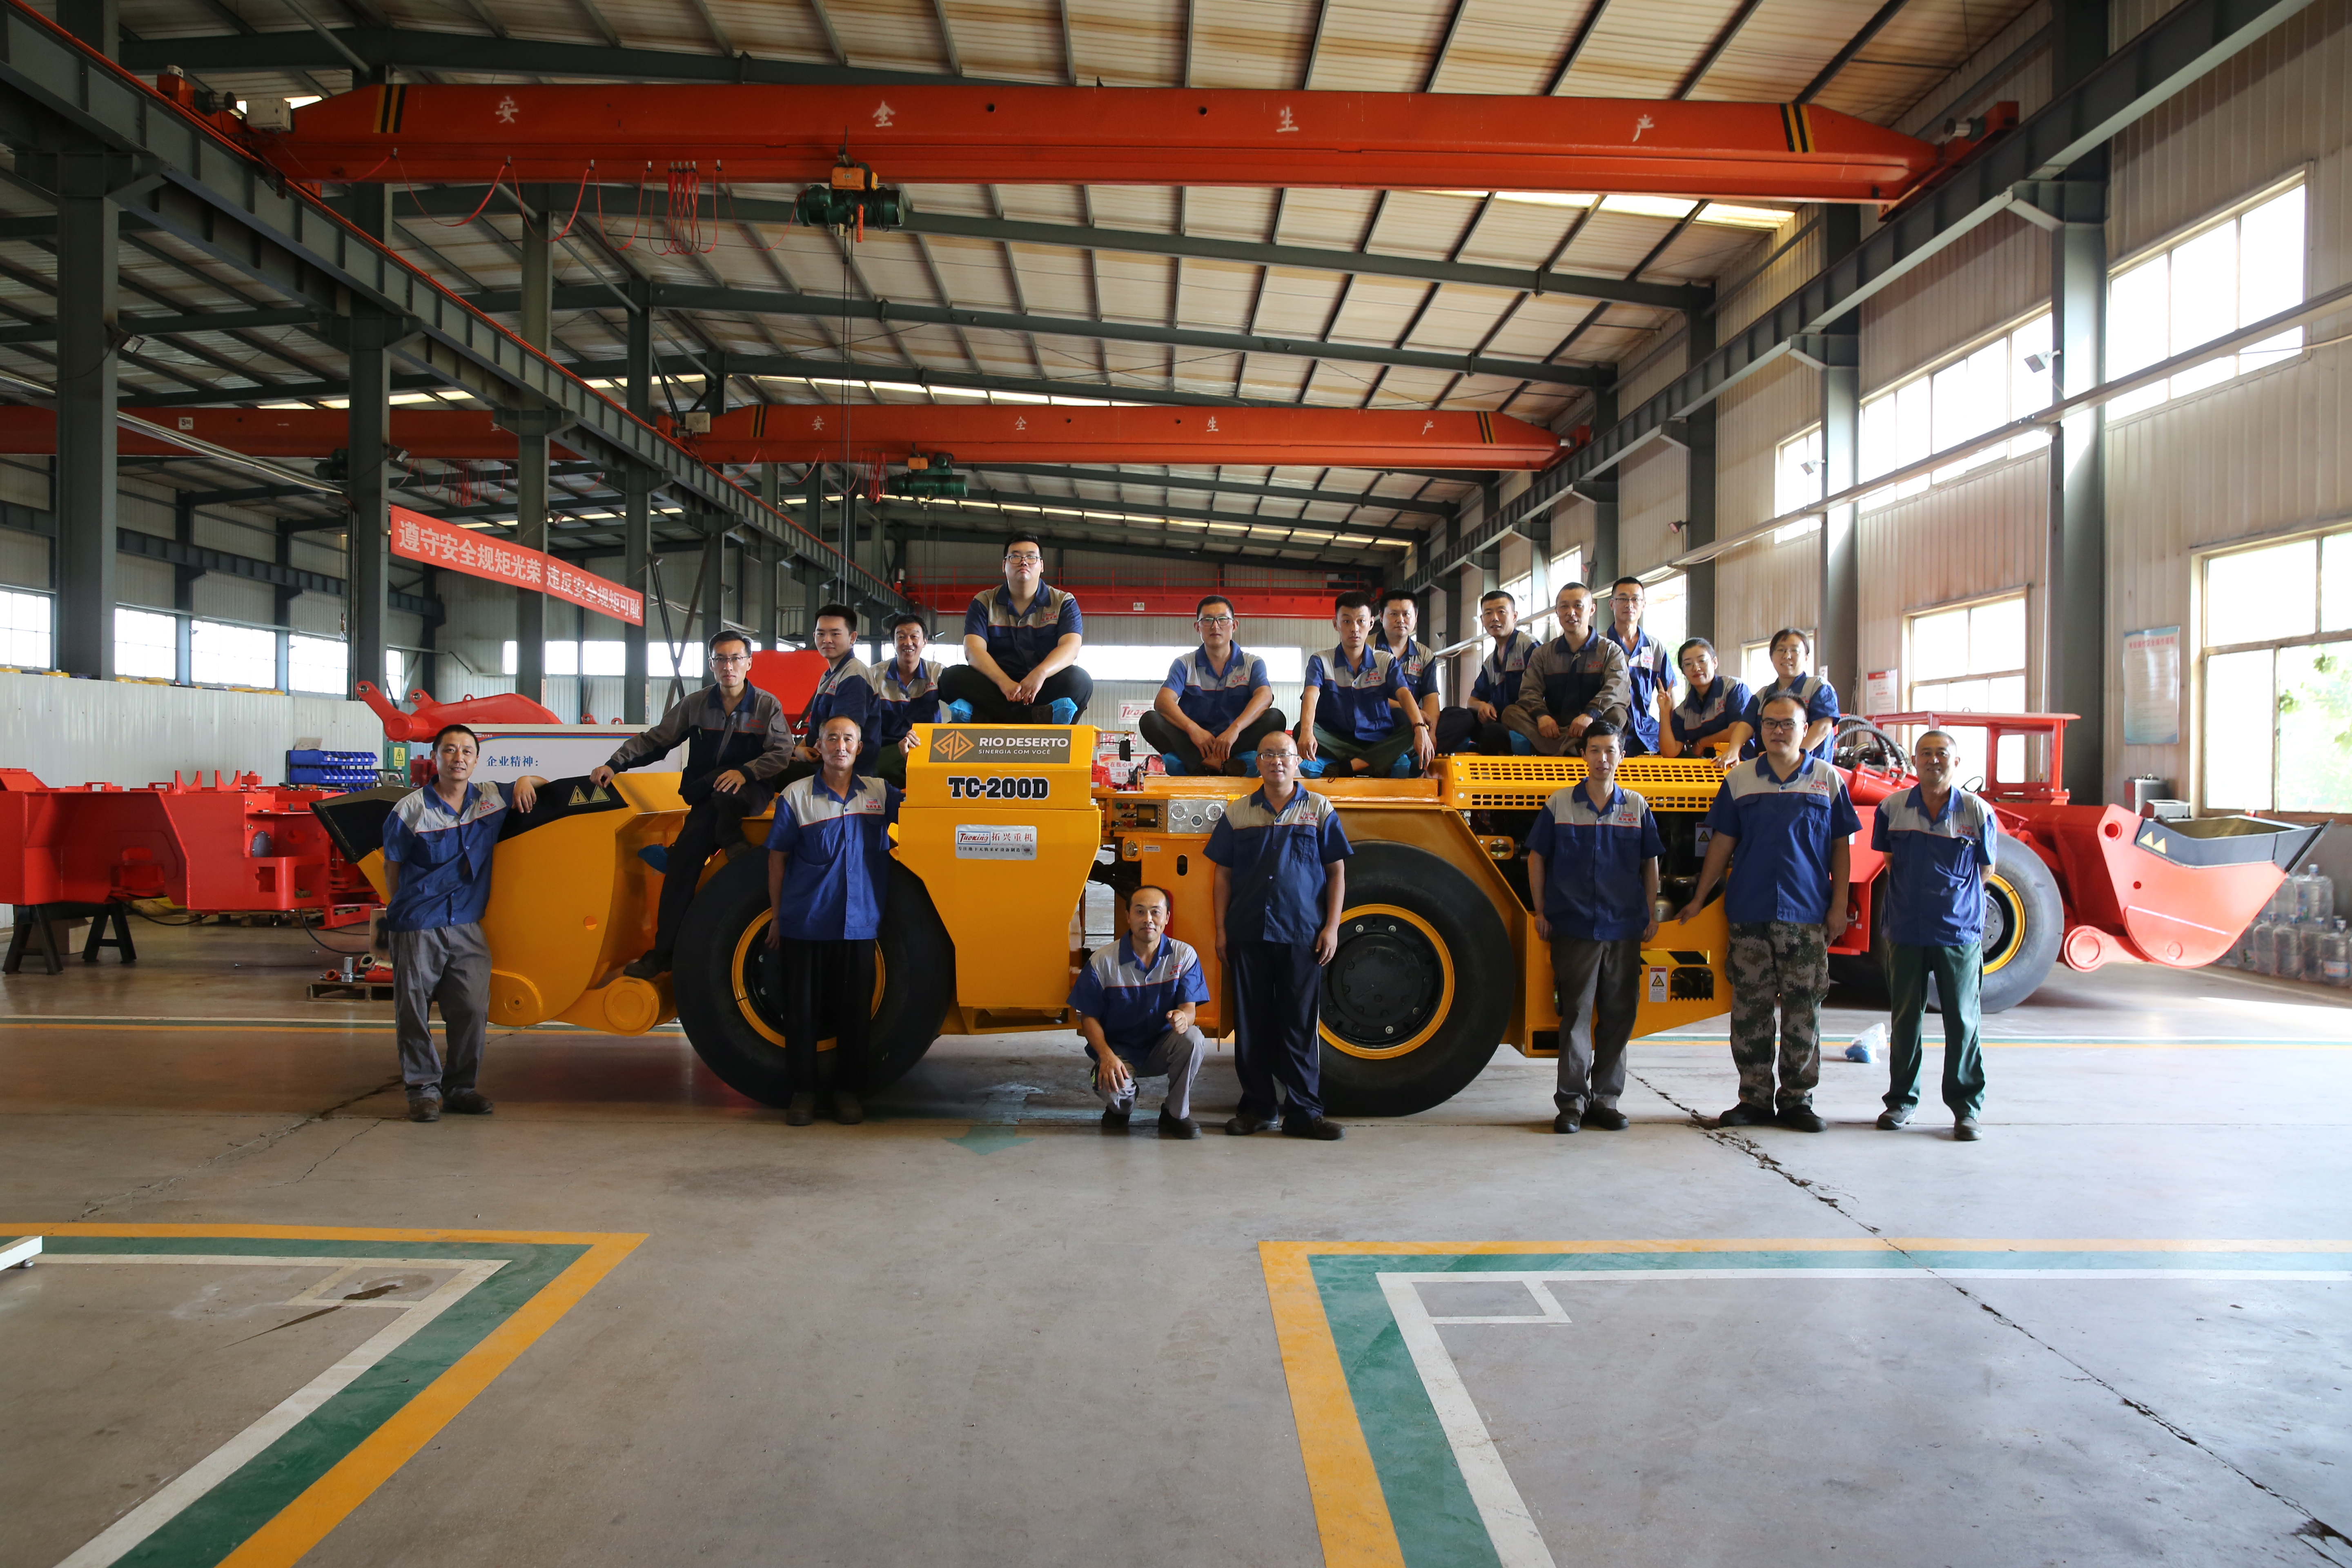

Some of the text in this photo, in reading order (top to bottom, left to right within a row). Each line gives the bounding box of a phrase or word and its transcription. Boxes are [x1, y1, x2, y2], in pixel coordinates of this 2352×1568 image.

[495, 96, 1654, 142] 安 全 生 产
[812, 416, 1434, 435] 安 全 生 产
[399, 521, 640, 619] 遵守安全规矩光荣 违反安全规矩可耻
[979, 737, 1069, 748] RIO DESERTO
[948, 777, 1049, 799] TC-200D
[960, 833, 989, 842] Tuoxing
[991, 832, 1033, 842] 拓兴重机
